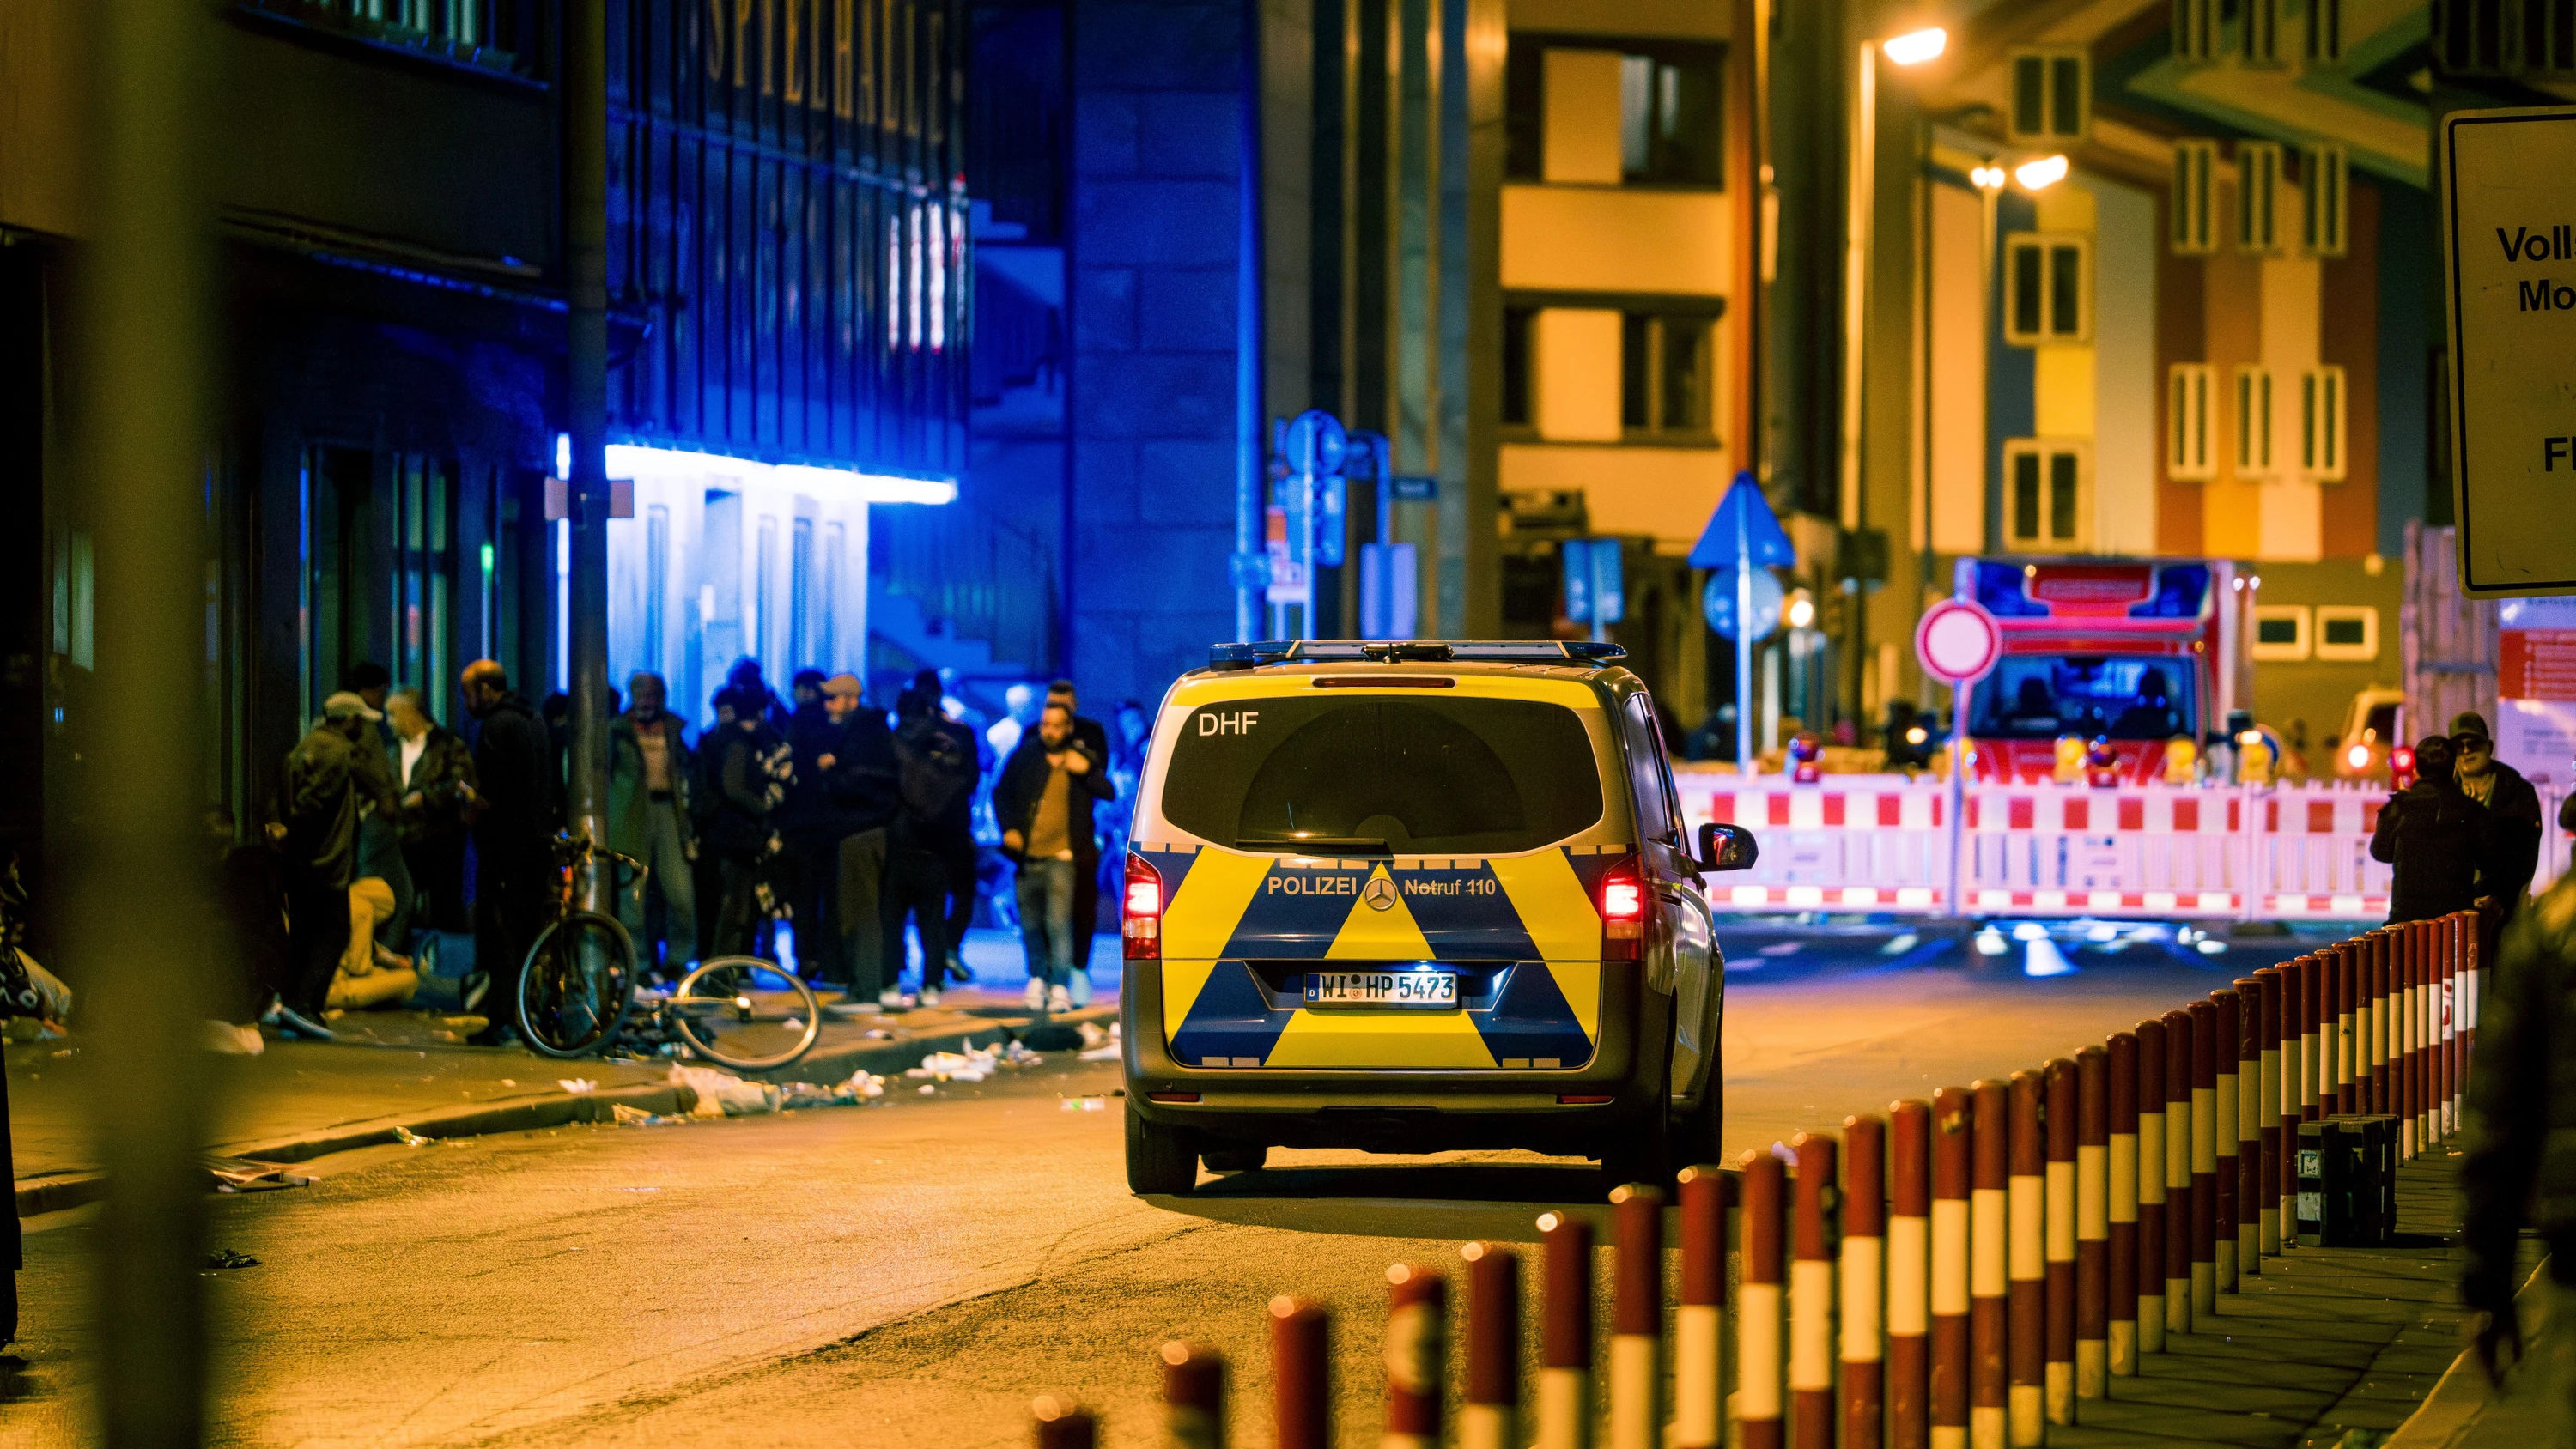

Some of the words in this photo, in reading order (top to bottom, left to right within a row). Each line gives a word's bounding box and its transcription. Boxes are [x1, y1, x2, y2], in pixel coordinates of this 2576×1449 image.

[2496, 224, 2576, 262] Voll
[1199, 712, 1259, 737] DHF
[1268, 876, 1357, 895] POLIZEI
[1405, 879, 1461, 895] Notruf
[1467, 879, 1496, 895] 110
[1322, 975, 1346, 998] WI
[1366, 975, 1393, 998] HP
[1399, 976, 1454, 999] 5473
